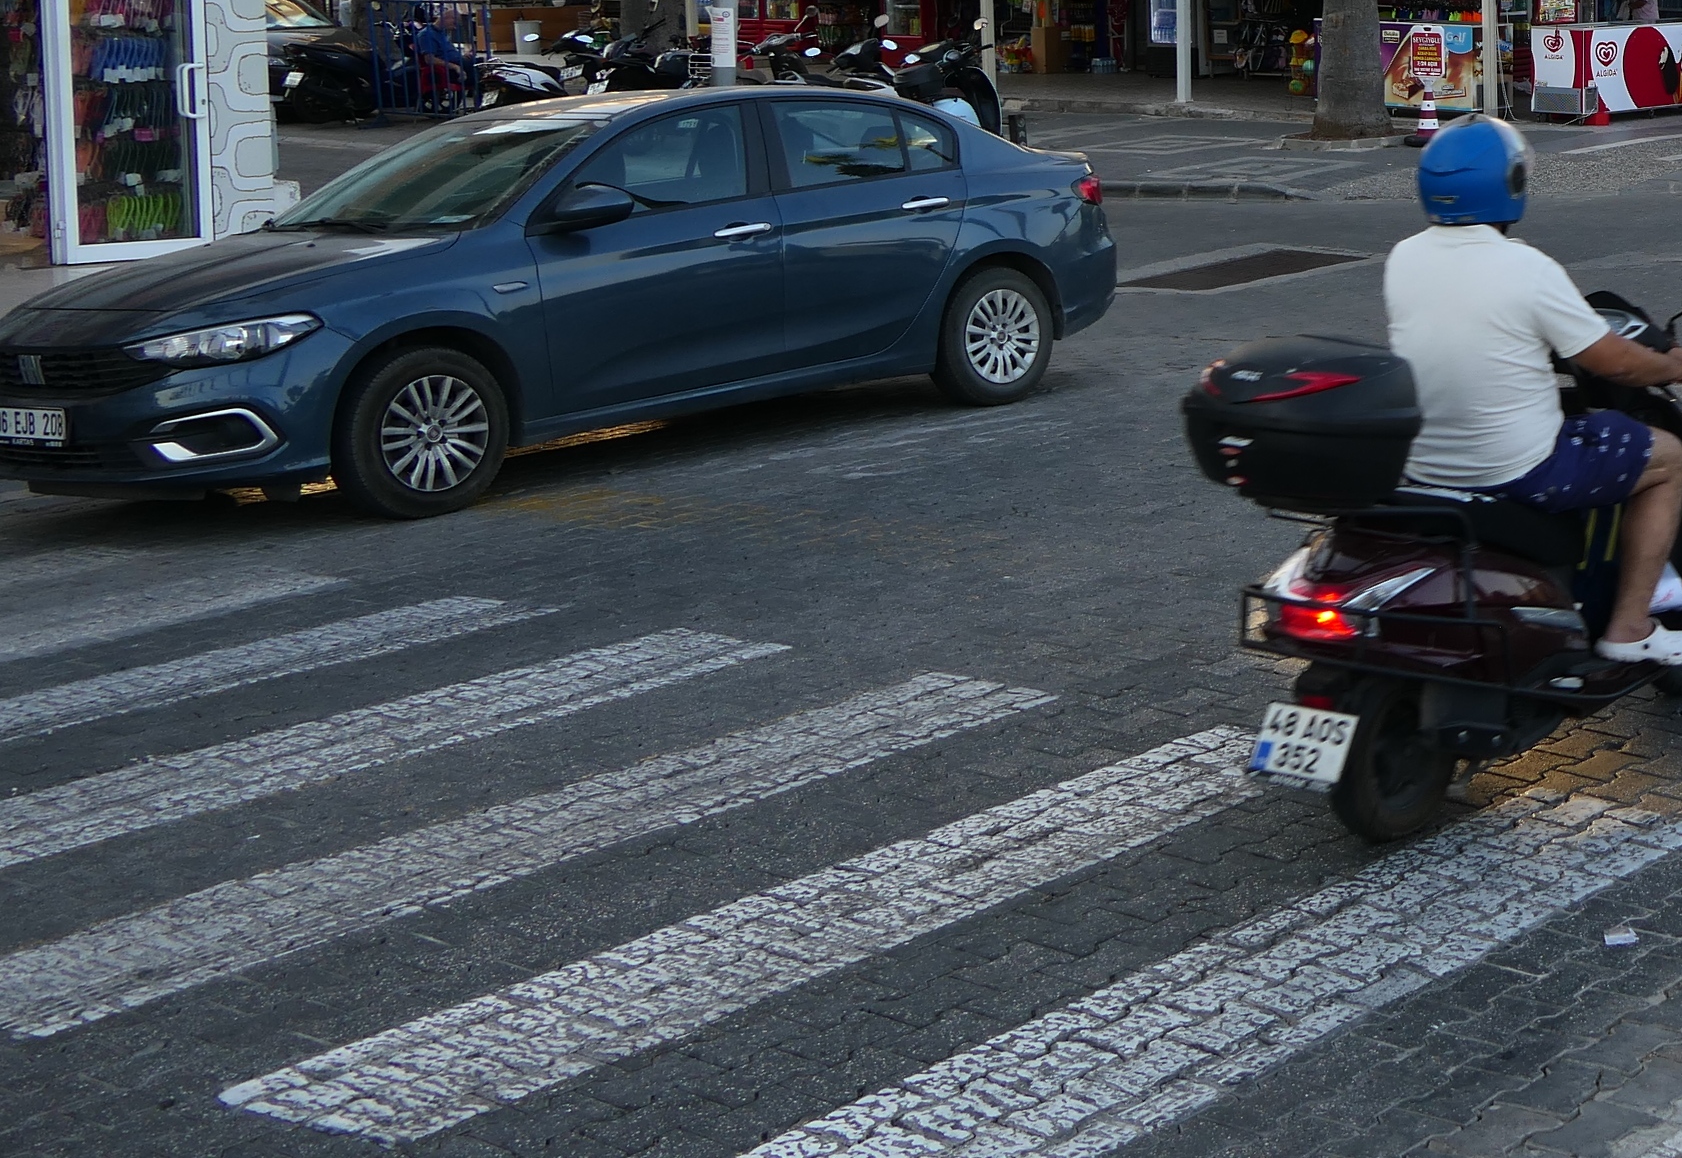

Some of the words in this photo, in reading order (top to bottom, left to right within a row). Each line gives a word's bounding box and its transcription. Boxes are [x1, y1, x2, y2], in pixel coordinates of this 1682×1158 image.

[1595, 69, 1617, 78] ALGIDA
[14, 411, 35, 435] EJB
[1269, 709, 1300, 737] 48
[1275, 742, 1320, 774] 352
